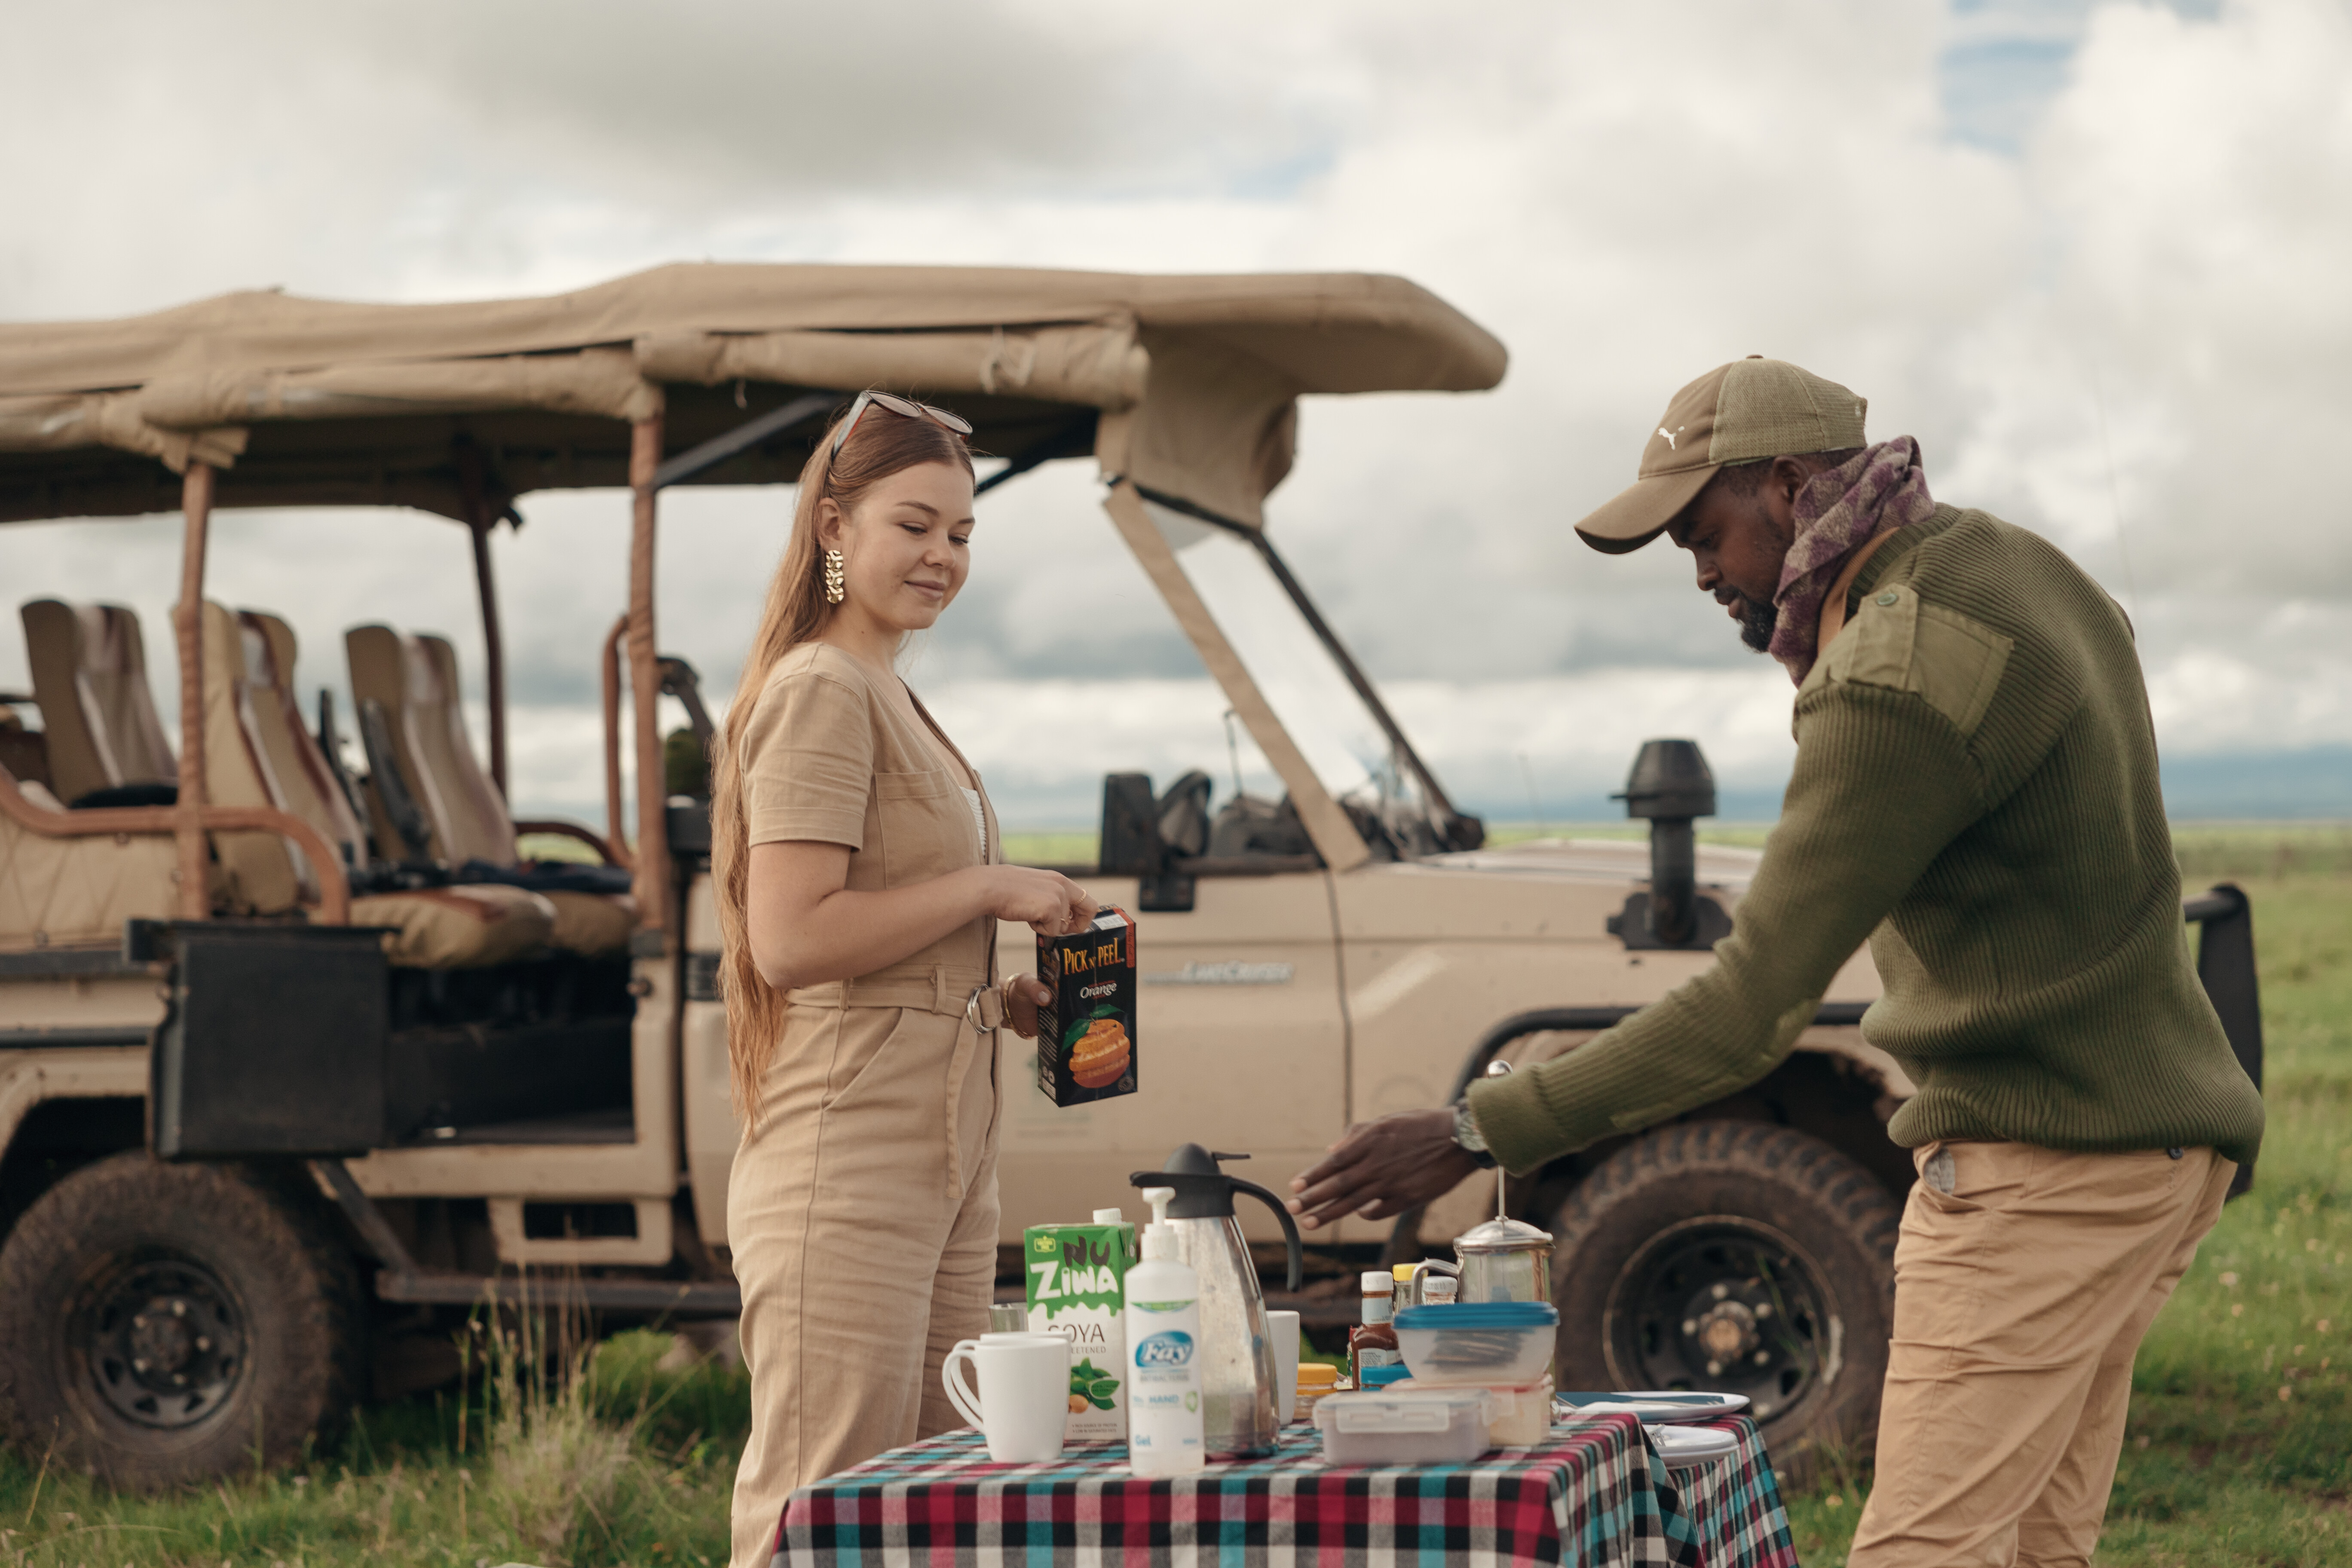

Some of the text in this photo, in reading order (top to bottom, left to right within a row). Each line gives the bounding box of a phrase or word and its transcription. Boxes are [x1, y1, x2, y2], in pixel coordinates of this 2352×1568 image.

[1063, 948, 1089, 975] PICK
[1097, 937, 1121, 967] PEEL
[1080, 983, 1117, 998] Orange
[1064, 1235, 1111, 1267] NU
[1143, 1340, 1190, 1364] Fay
[1149, 1395, 1179, 1403] HAND
